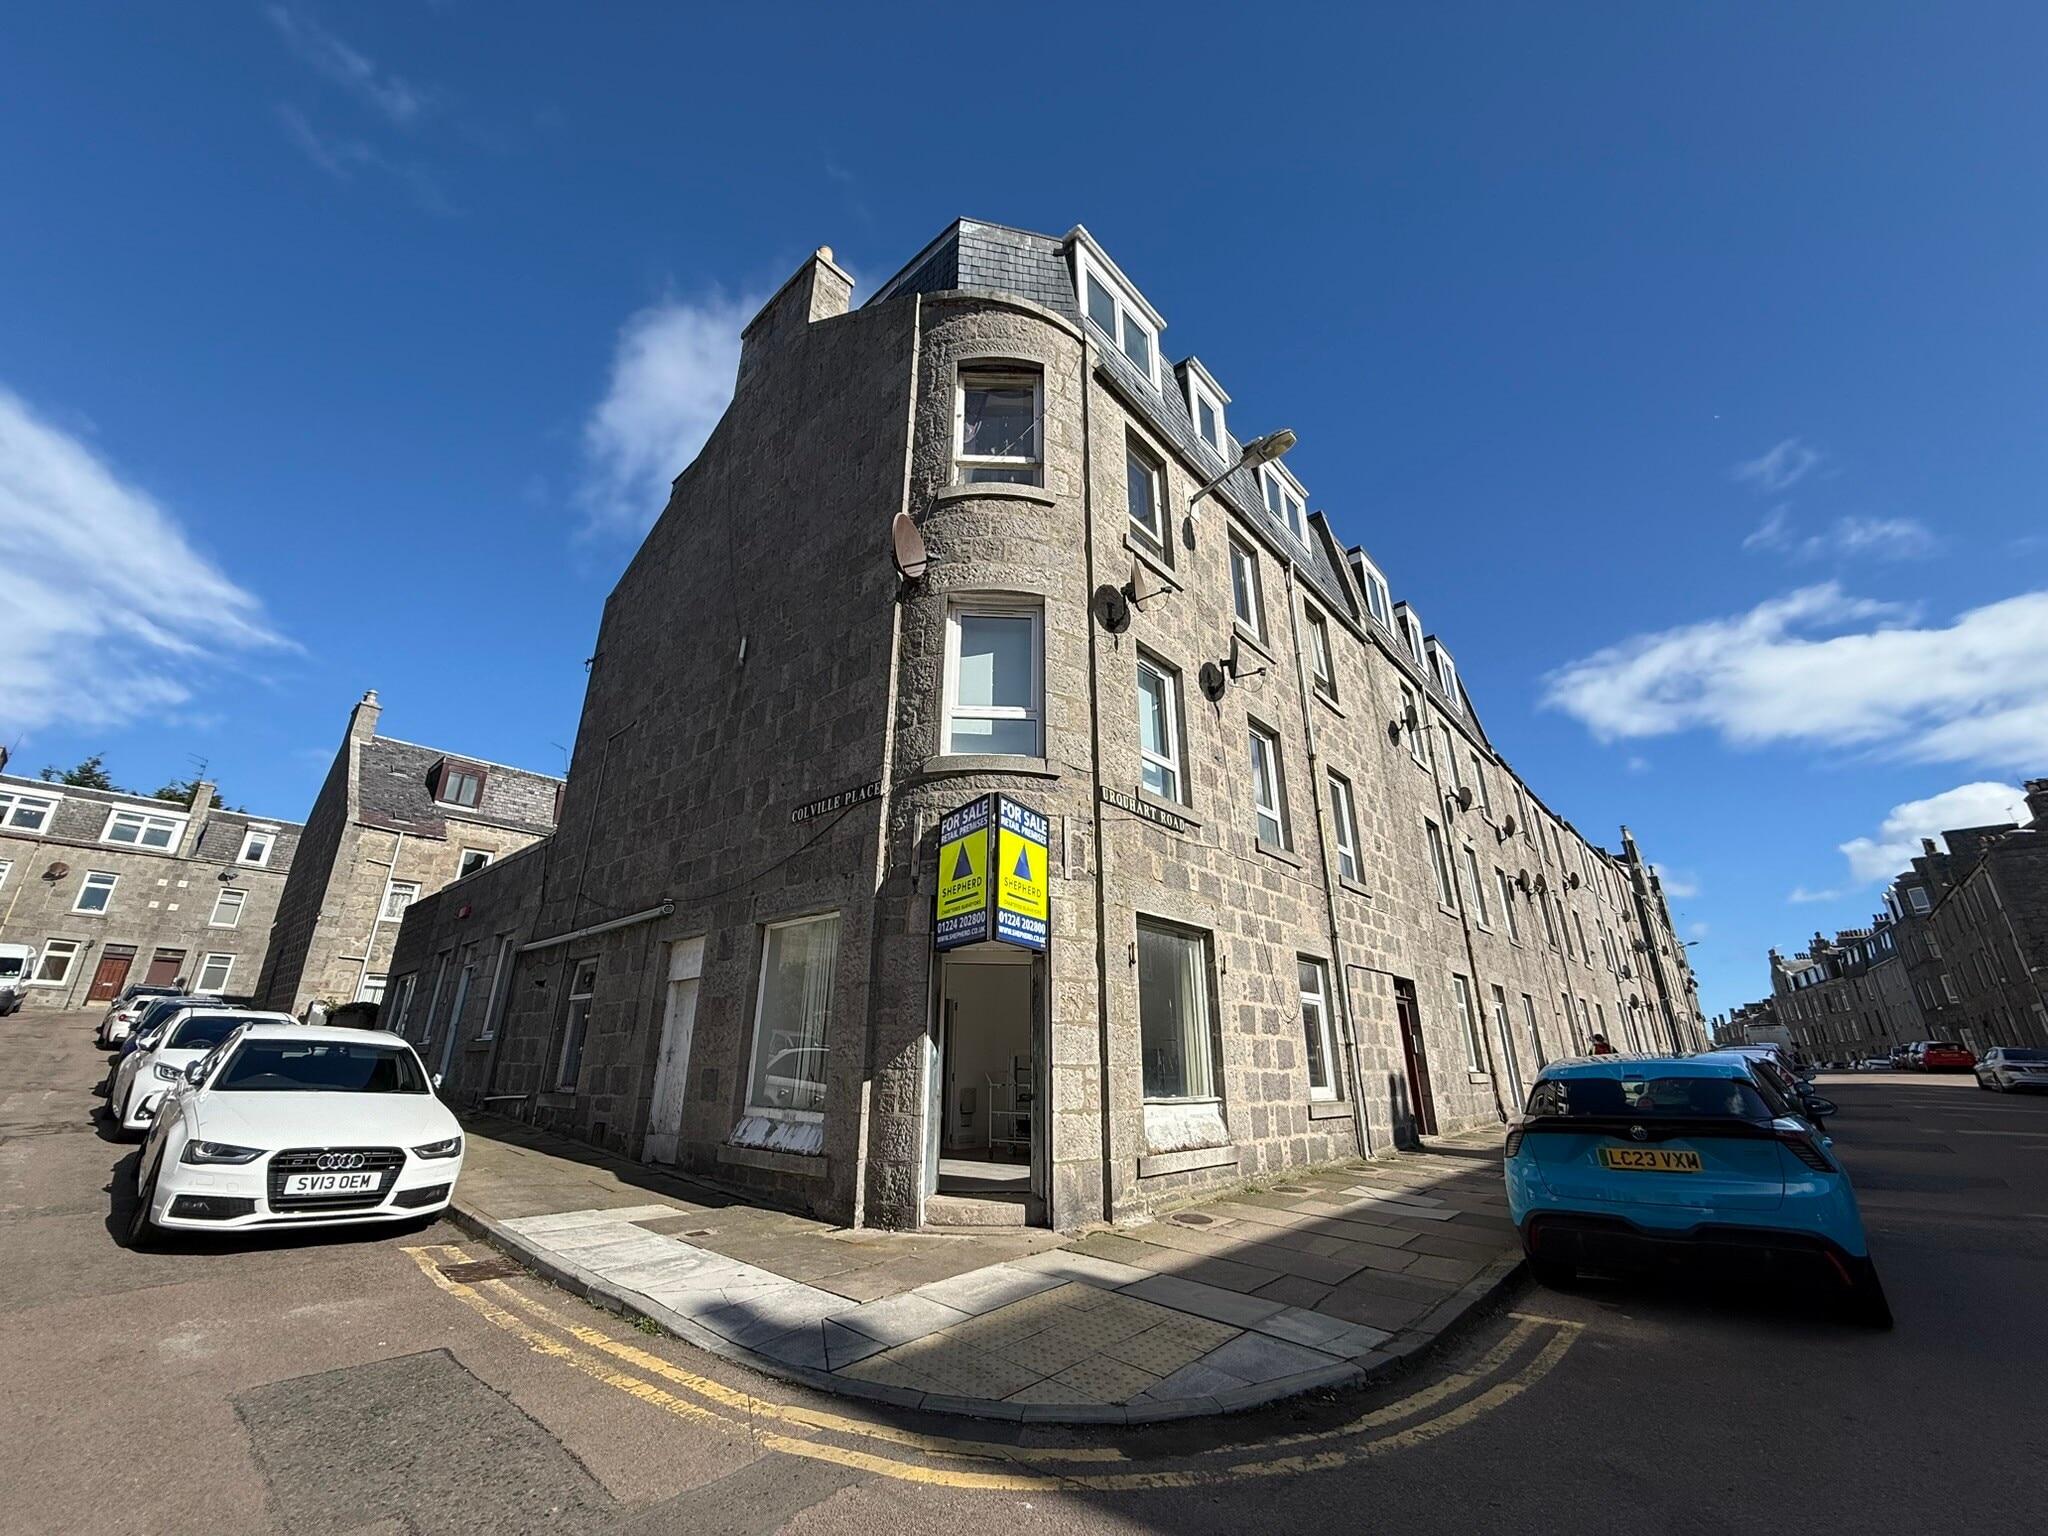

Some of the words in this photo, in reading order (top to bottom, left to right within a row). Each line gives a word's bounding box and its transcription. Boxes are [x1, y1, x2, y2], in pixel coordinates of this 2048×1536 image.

[792, 796, 840, 822] COLVILLE
[844, 781, 881, 806] PLACE
[1102, 786, 1156, 820] URQUHART
[1160, 812, 1185, 831] ROAD
[940, 829, 959, 844] RETAIL
[959, 815, 988, 836] PREMISES
[941, 813, 960, 835] FOR
[962, 800, 988, 824] SALE
[1000, 799, 1022, 824] FOR
[1023, 810, 1048, 836] SALE
[1000, 815, 1021, 833] RETAIL
[1021, 825, 1047, 845] PREMISES
[942, 876, 982, 898] SHEPHERD
[1004, 877, 1041, 898] SHEPHERD
[937, 919, 958, 934] 01224
[959, 910, 986, 928] 202800
[999, 910, 1021, 928] 01224
[1021, 917, 1046, 935] 202800
[1608, 1150, 1656, 1167] LC23
[1661, 1152, 1700, 1169] VXM
[296, 1176, 336, 1191] SV13
[338, 1174, 372, 1189] OEM
